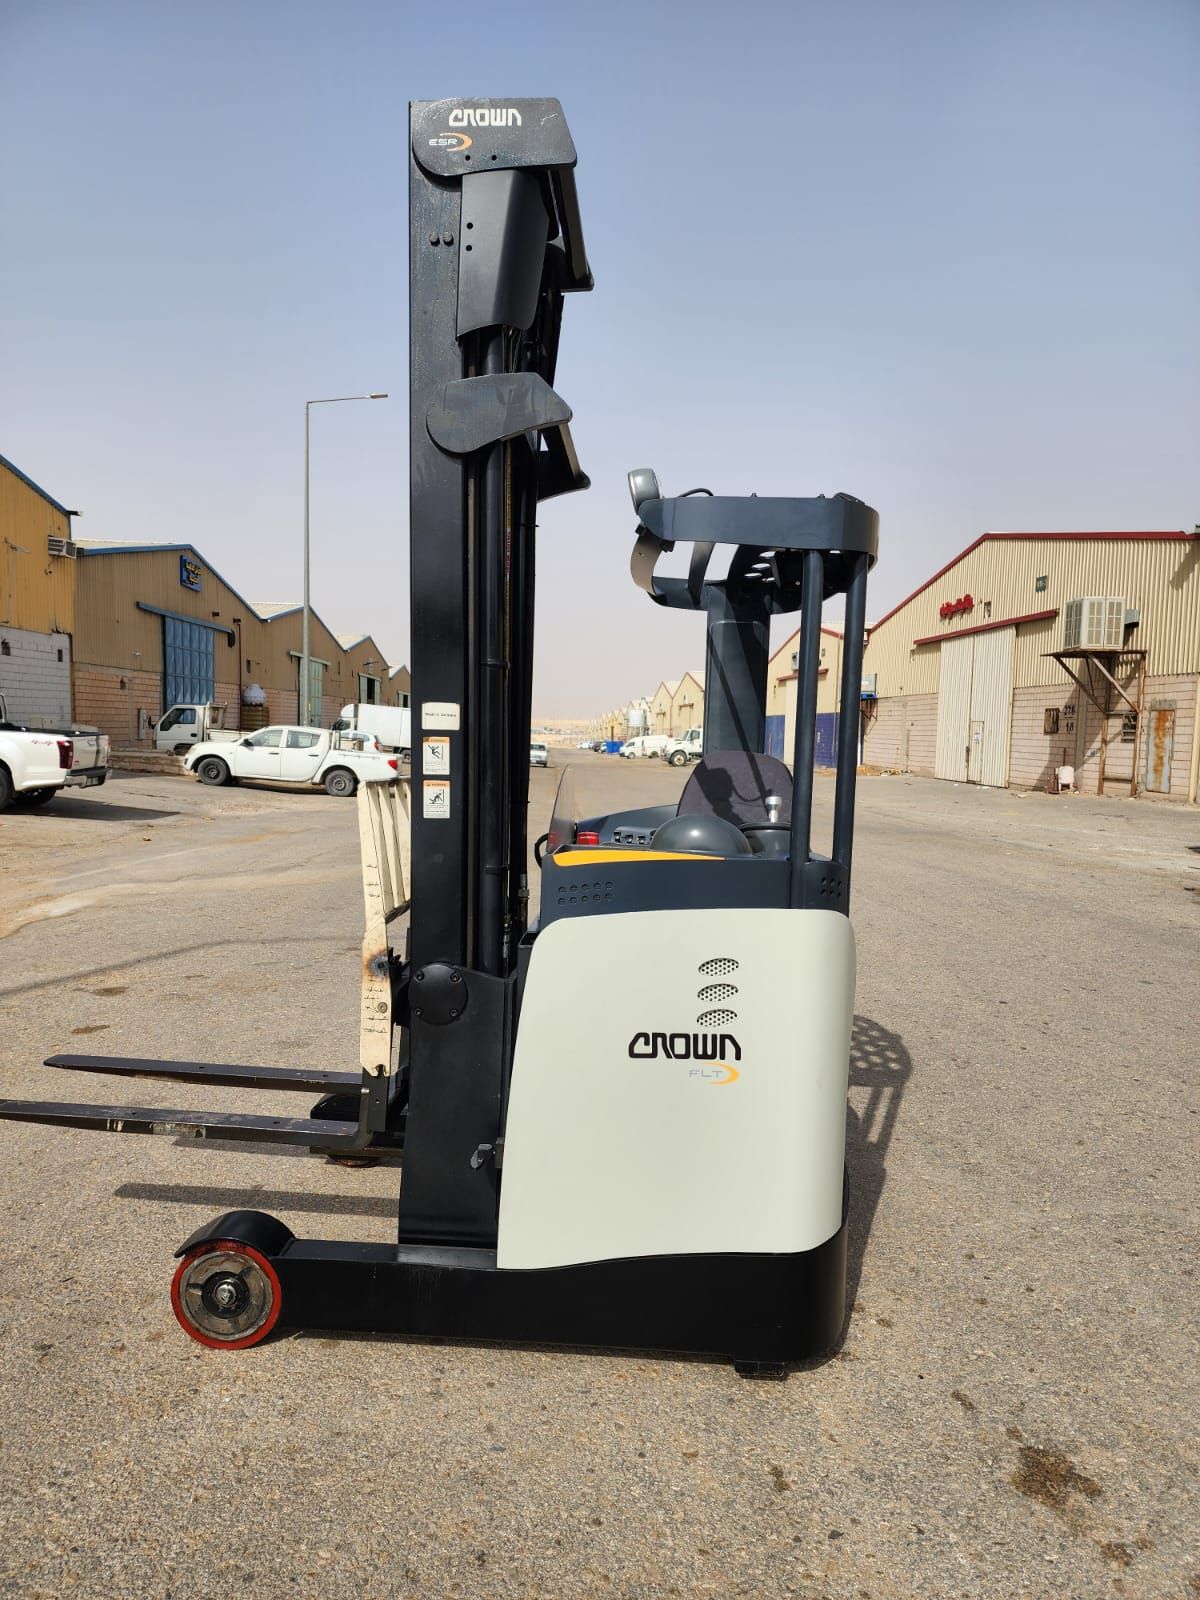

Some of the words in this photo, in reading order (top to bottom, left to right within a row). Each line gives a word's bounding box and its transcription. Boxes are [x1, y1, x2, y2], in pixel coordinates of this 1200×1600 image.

[448, 108, 522, 127] CROWN
[428, 137, 458, 146] ESR
[628, 1032, 742, 1061] CROWN
[688, 1069, 724, 1078] FLT
